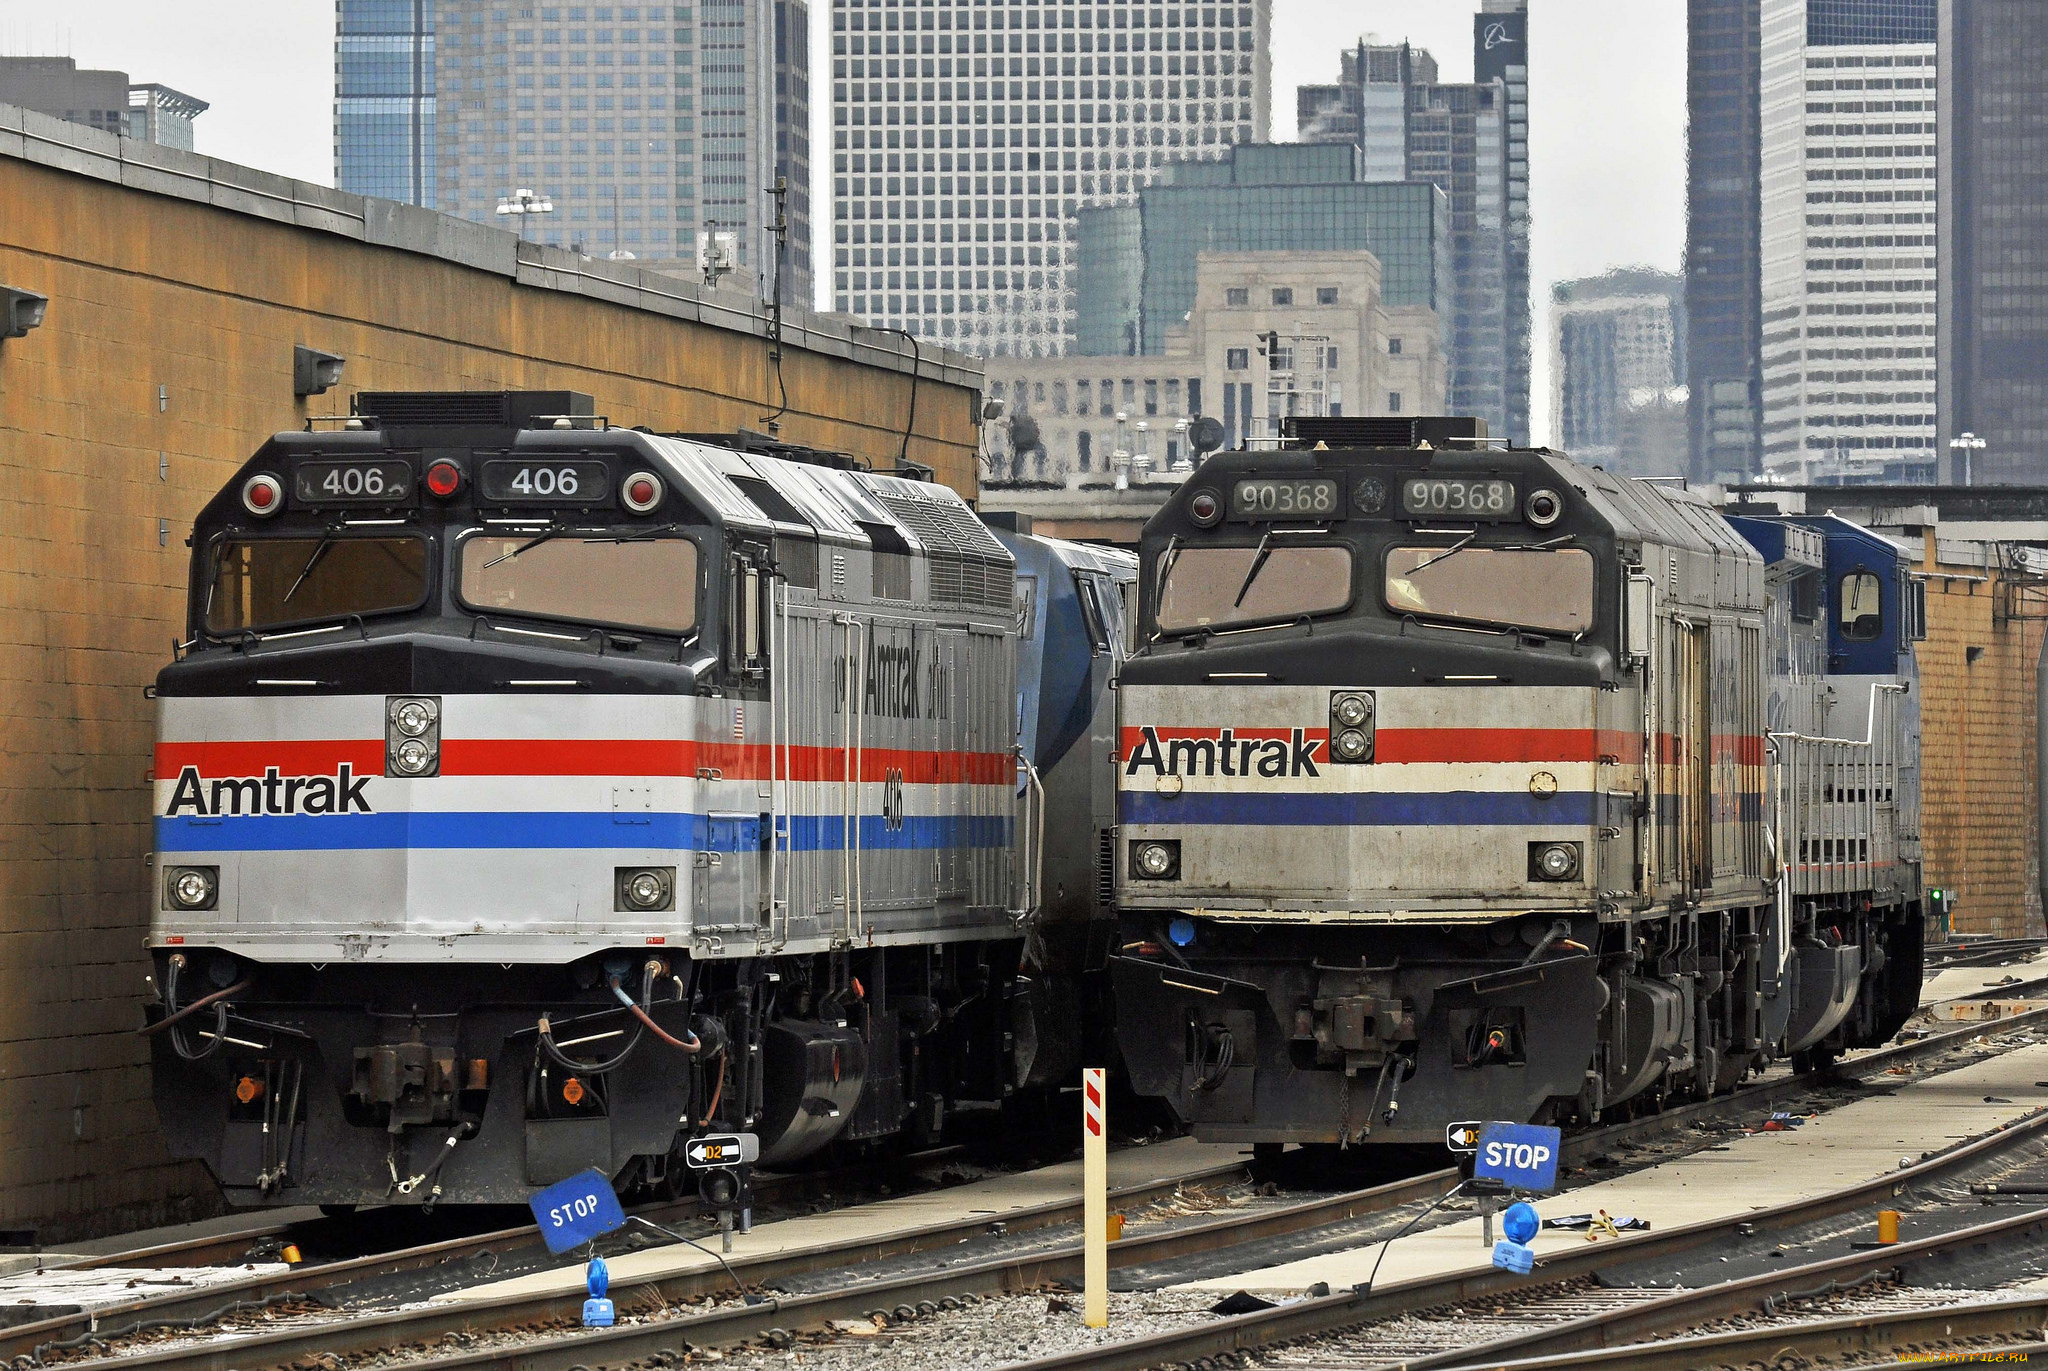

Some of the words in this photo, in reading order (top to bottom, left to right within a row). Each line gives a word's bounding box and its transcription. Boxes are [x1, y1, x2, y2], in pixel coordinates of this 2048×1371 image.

[322, 468, 384, 495] 406
[511, 468, 579, 495] 406
[1242, 485, 1330, 511] 90368
[1412, 483, 1504, 510] 90368
[865, 618, 920, 719] Amtrak
[1126, 726, 1321, 777] Amtrak
[165, 764, 374, 816] Amtrak
[883, 767, 903, 832] 406
[706, 1145, 722, 1160] D2
[1485, 1142, 1550, 1170] STOP
[550, 1194, 598, 1227] STOP
